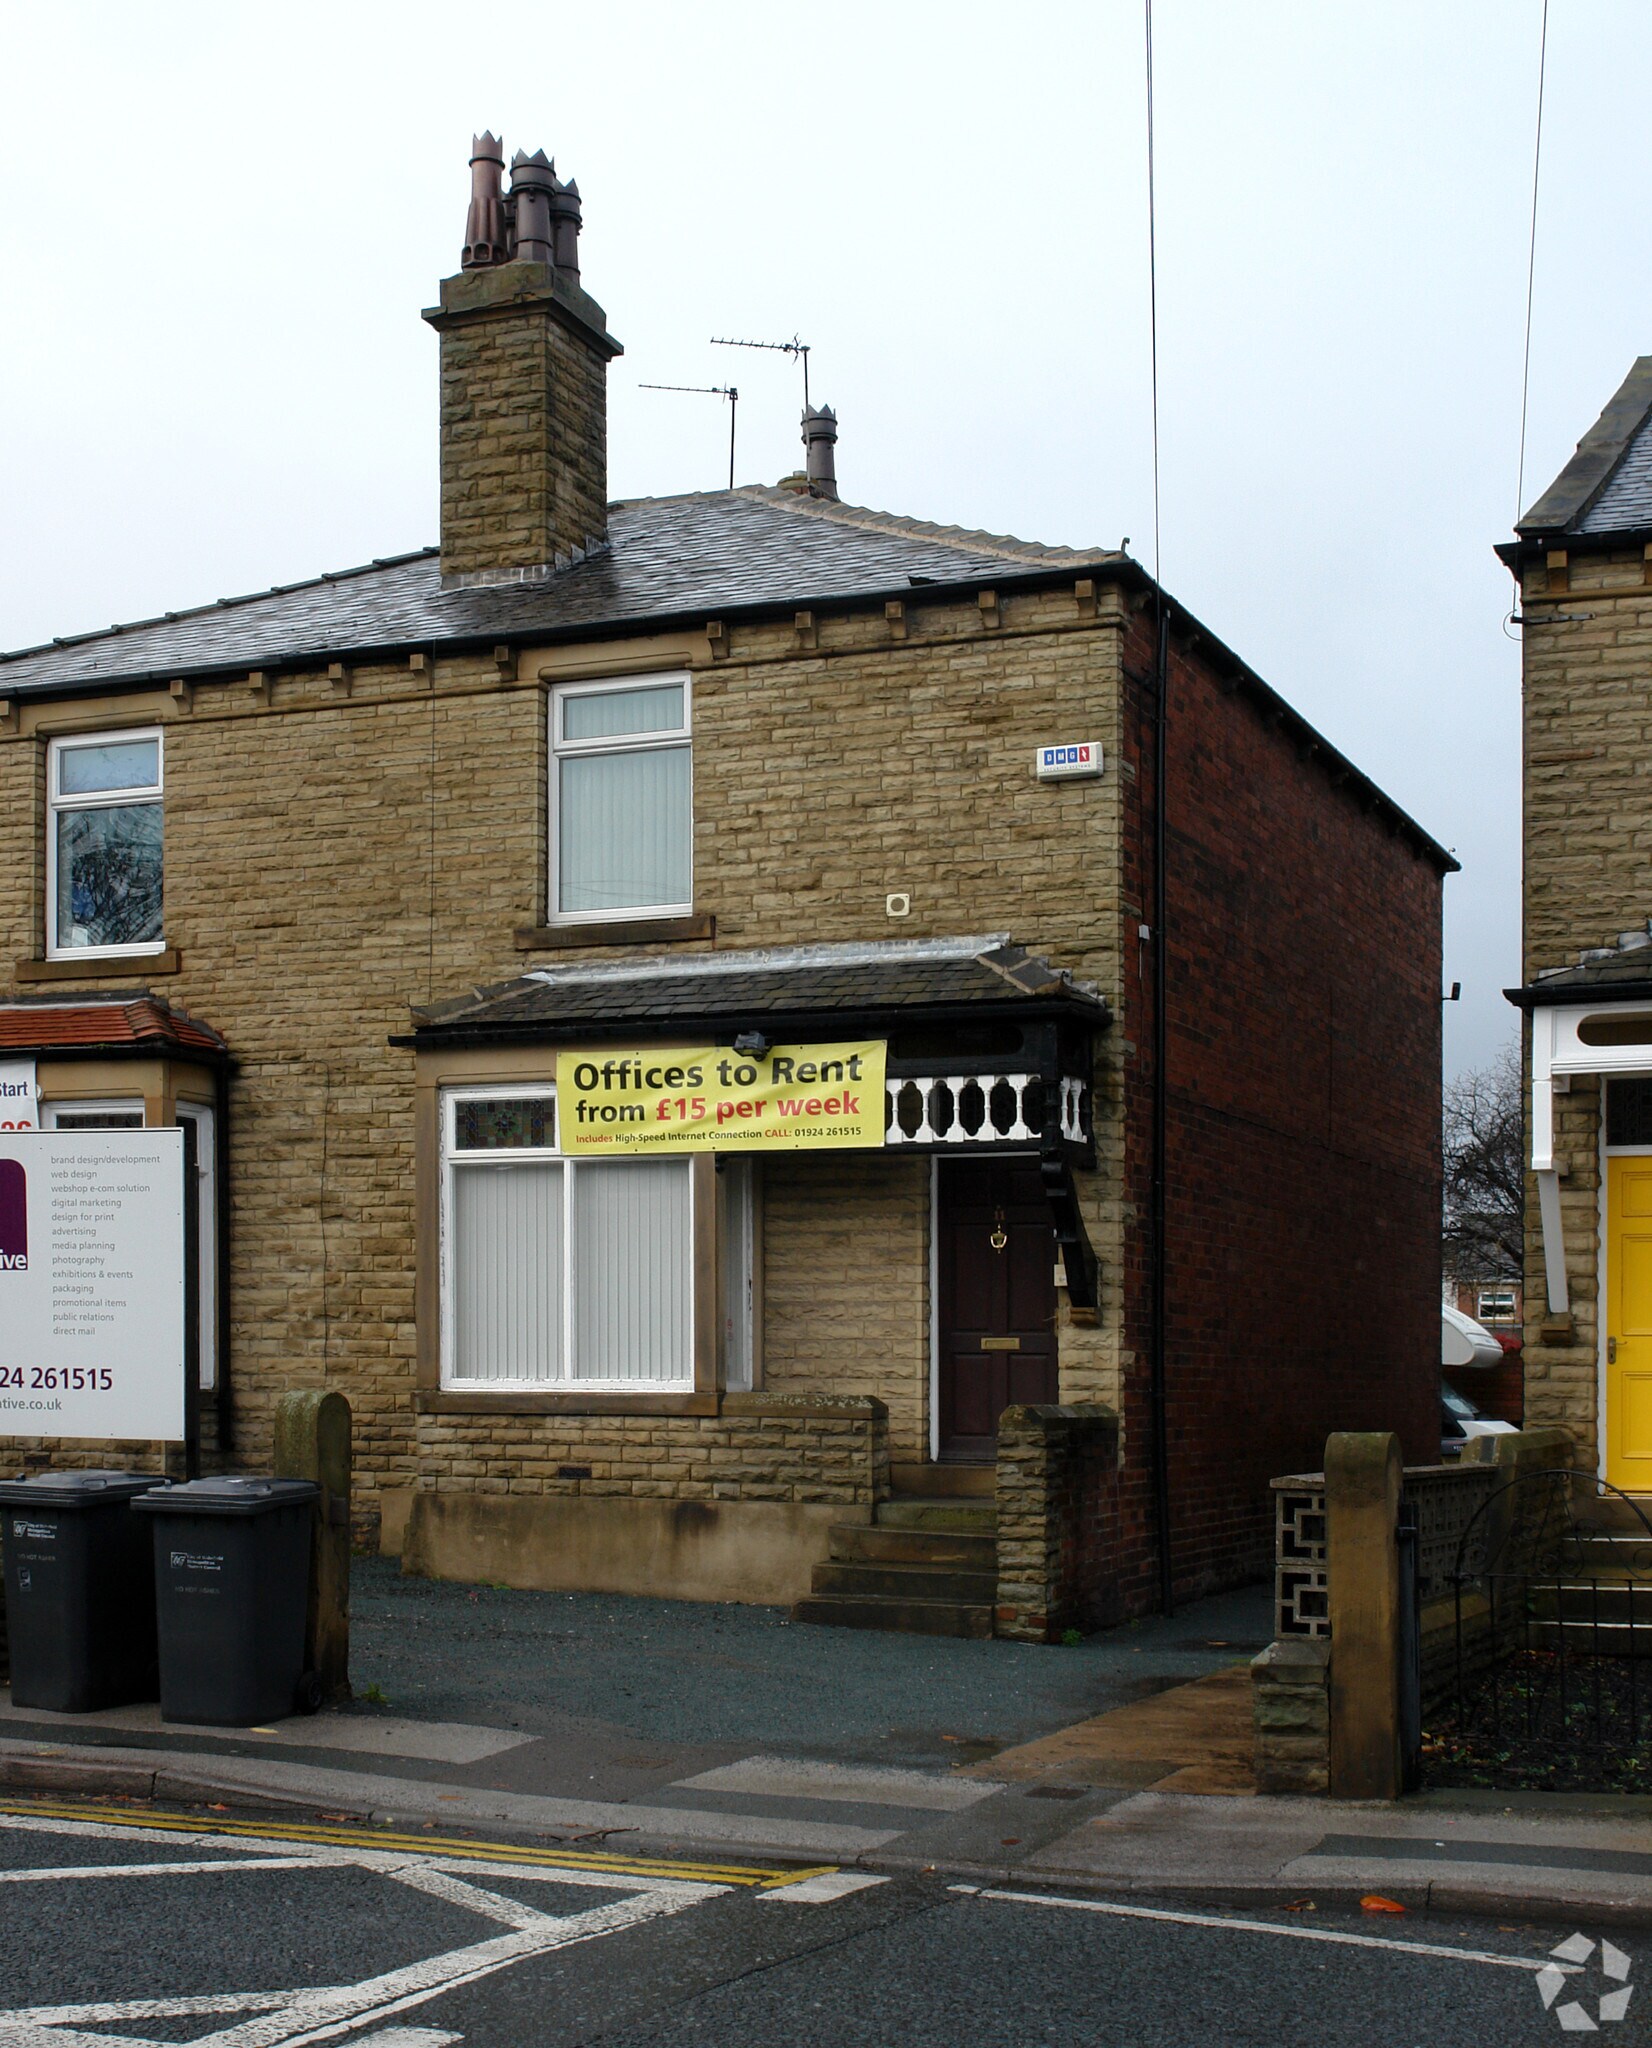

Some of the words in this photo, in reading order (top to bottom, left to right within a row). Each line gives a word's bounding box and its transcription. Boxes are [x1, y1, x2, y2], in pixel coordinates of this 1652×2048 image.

[574, 1060, 703, 1091] Offices
[716, 1059, 757, 1086] to
[772, 1054, 863, 1084] Rent
[0, 1081, 28, 1097] tart
[575, 1100, 645, 1123] from
[656, 1098, 706, 1121] £15
[716, 1100, 767, 1125] per
[777, 1090, 860, 1117] week
[576, 1134, 613, 1143] Includes
[615, 1132, 666, 1144] High-Speed
[668, 1132, 706, 1141] Internet
[709, 1130, 762, 1140] Connection
[765, 1129, 792, 1138] CALL:
[794, 1128, 823, 1137] 01924
[826, 1127, 861, 1136] 261515
[51, 1155, 75, 1164] brand
[77, 1155, 160, 1165] design/development
[51, 1170, 69, 1178] web
[71, 1170, 97, 1180] design
[51, 1184, 88, 1193] webshop
[51, 1199, 78, 1209] digital
[80, 1199, 122, 1208] marketing
[52, 1213, 78, 1222] design
[80, 1213, 92, 1221] for
[95, 1213, 115, 1223] print
[52, 1227, 96, 1237] advertising
[52, 1242, 77, 1250] media
[79, 1241, 116, 1251] planning
[52, 1256, 105, 1266] photography
[98, 1271, 105, 1279] &
[107, 1271, 133, 1279] events
[52, 1285, 94, 1294] packaging
[52, 1299, 103, 1308] promotional
[105, 1299, 127, 1307] items
[53, 1313, 77, 1322] public
[79, 1313, 114, 1321] relations
[53, 1327, 76, 1335] direct
[78, 1327, 96, 1335] mail
[0, 1367, 25, 1388] 24
[31, 1367, 113, 1390] 261515
[0, 1398, 62, 1411] tive.co.uk
